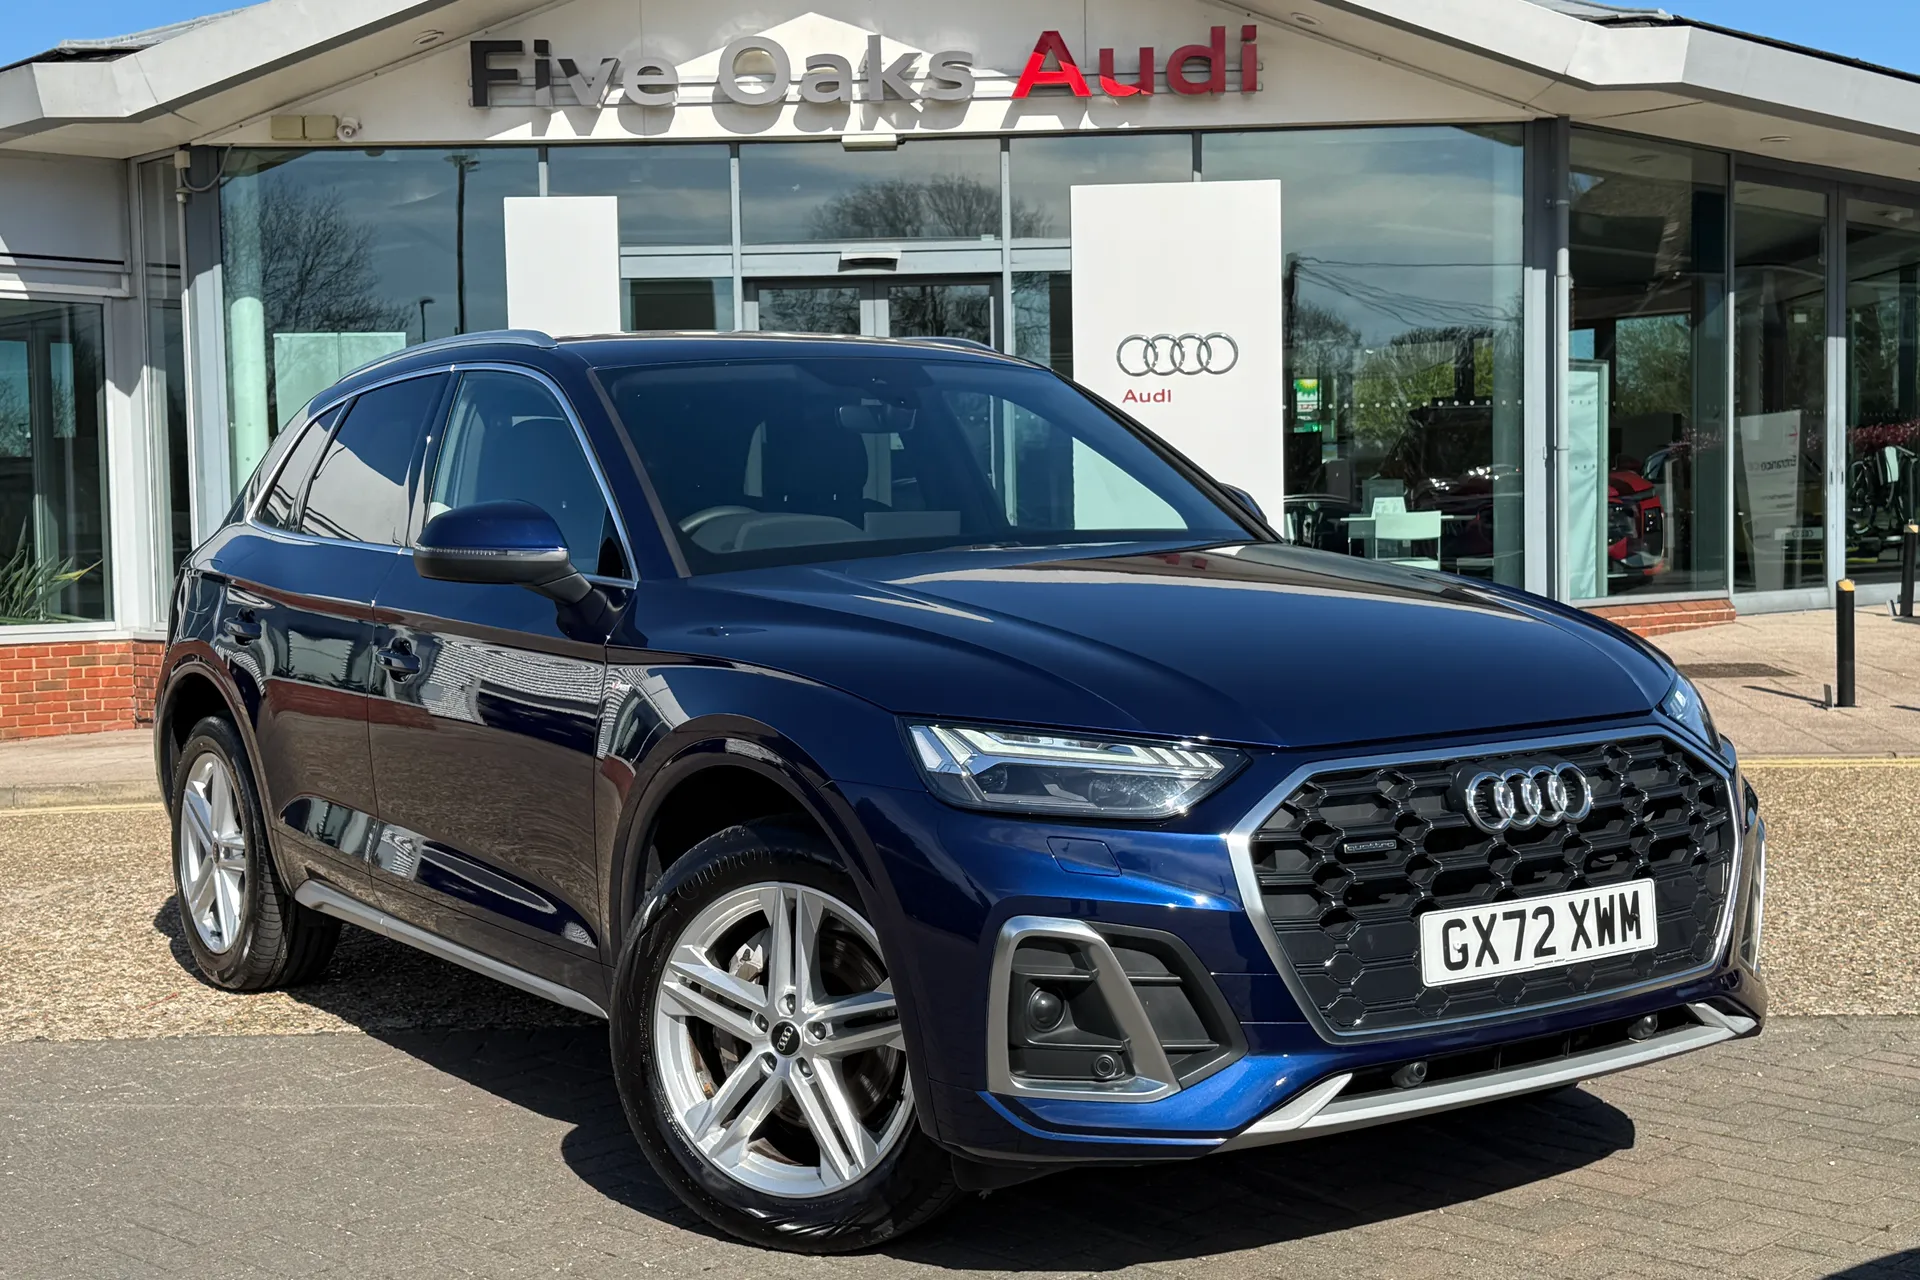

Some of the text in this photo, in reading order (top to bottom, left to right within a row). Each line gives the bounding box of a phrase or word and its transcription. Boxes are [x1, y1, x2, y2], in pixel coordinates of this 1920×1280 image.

[470, 24, 1257, 107] Five Oaks Audi
[1122, 388, 1172, 403] Audi
[1346, 841, 1395, 852] quattro
[1441, 890, 1642, 971] GX72 XWM
